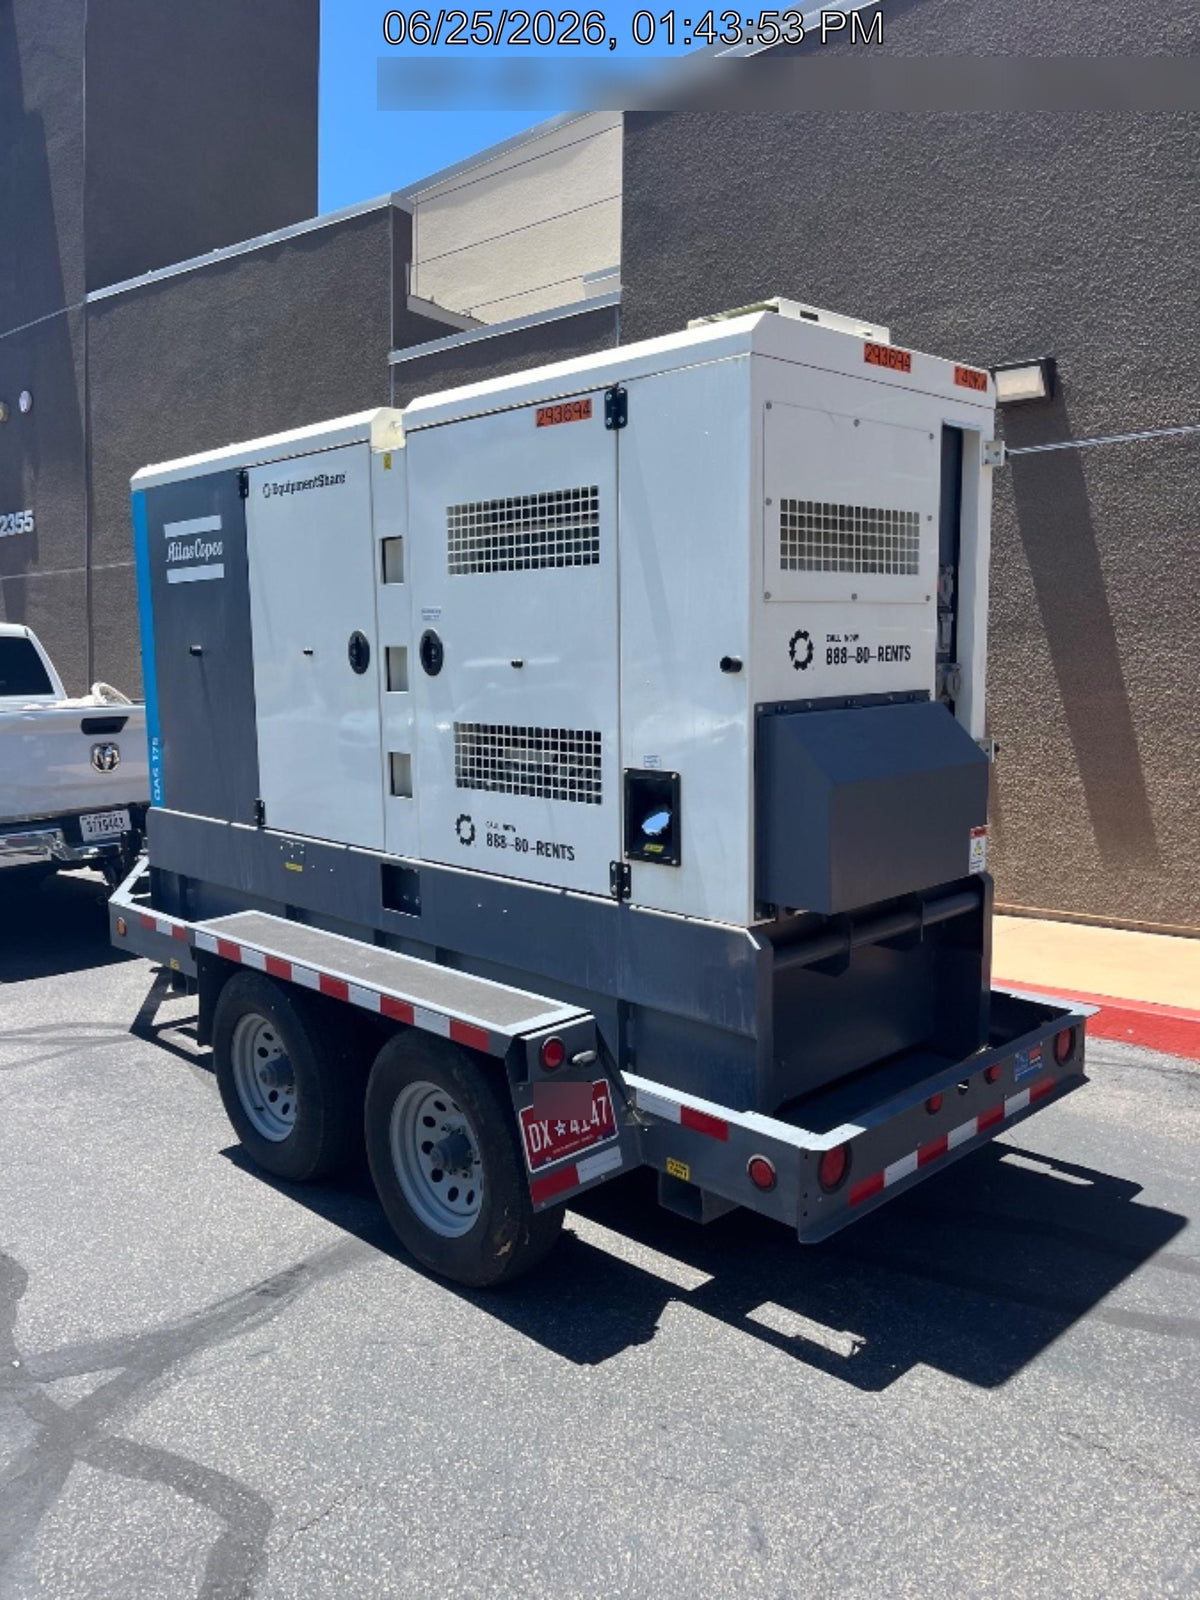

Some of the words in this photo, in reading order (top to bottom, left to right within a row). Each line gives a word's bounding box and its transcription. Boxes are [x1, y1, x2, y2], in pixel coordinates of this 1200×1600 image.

[536, 399, 592, 427] 293694
[272, 474, 345, 496] EquipmentShare
[826, 645, 911, 665] 888-80-RENTS
[486, 832, 575, 861] 888-80-RENTS
[528, 1119, 553, 1153] DX
